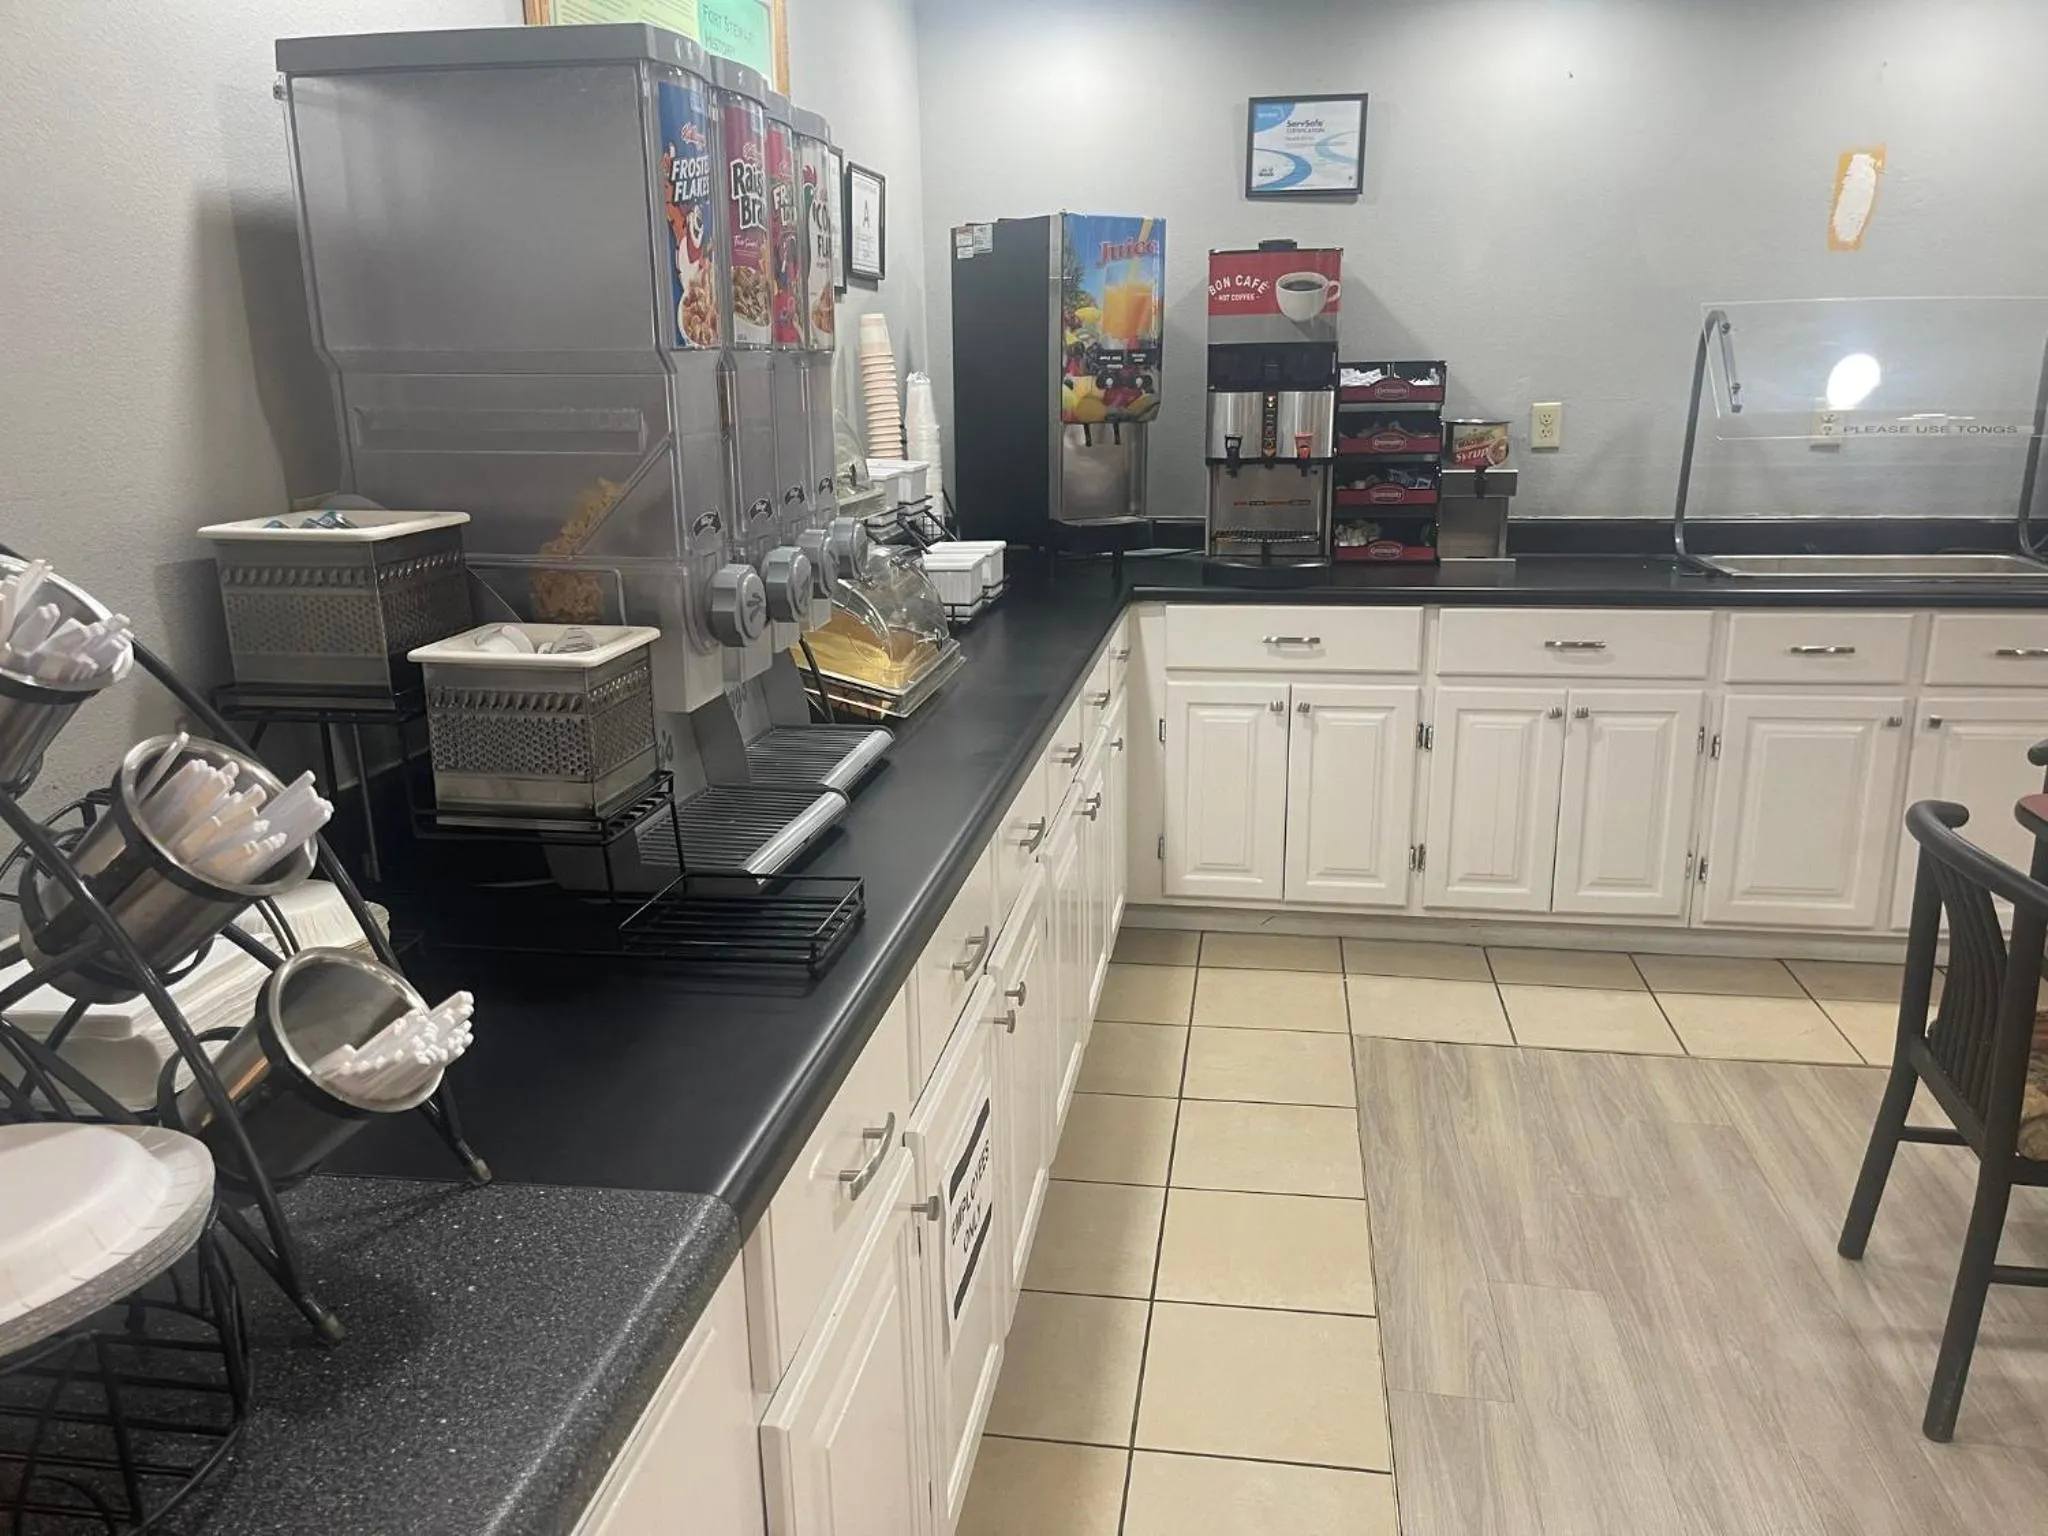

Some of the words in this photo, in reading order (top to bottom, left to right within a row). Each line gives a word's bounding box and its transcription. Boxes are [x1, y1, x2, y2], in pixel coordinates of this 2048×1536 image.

[671, 155, 710, 181] FROSTE
[731, 158, 765, 200] Rais
[1096, 237, 1159, 268] Juice
[1209, 276, 1231, 296] BON
[1843, 425, 1909, 434] PLEASE
[1916, 425, 1950, 434] USE
[1957, 425, 2018, 434] TONGS
